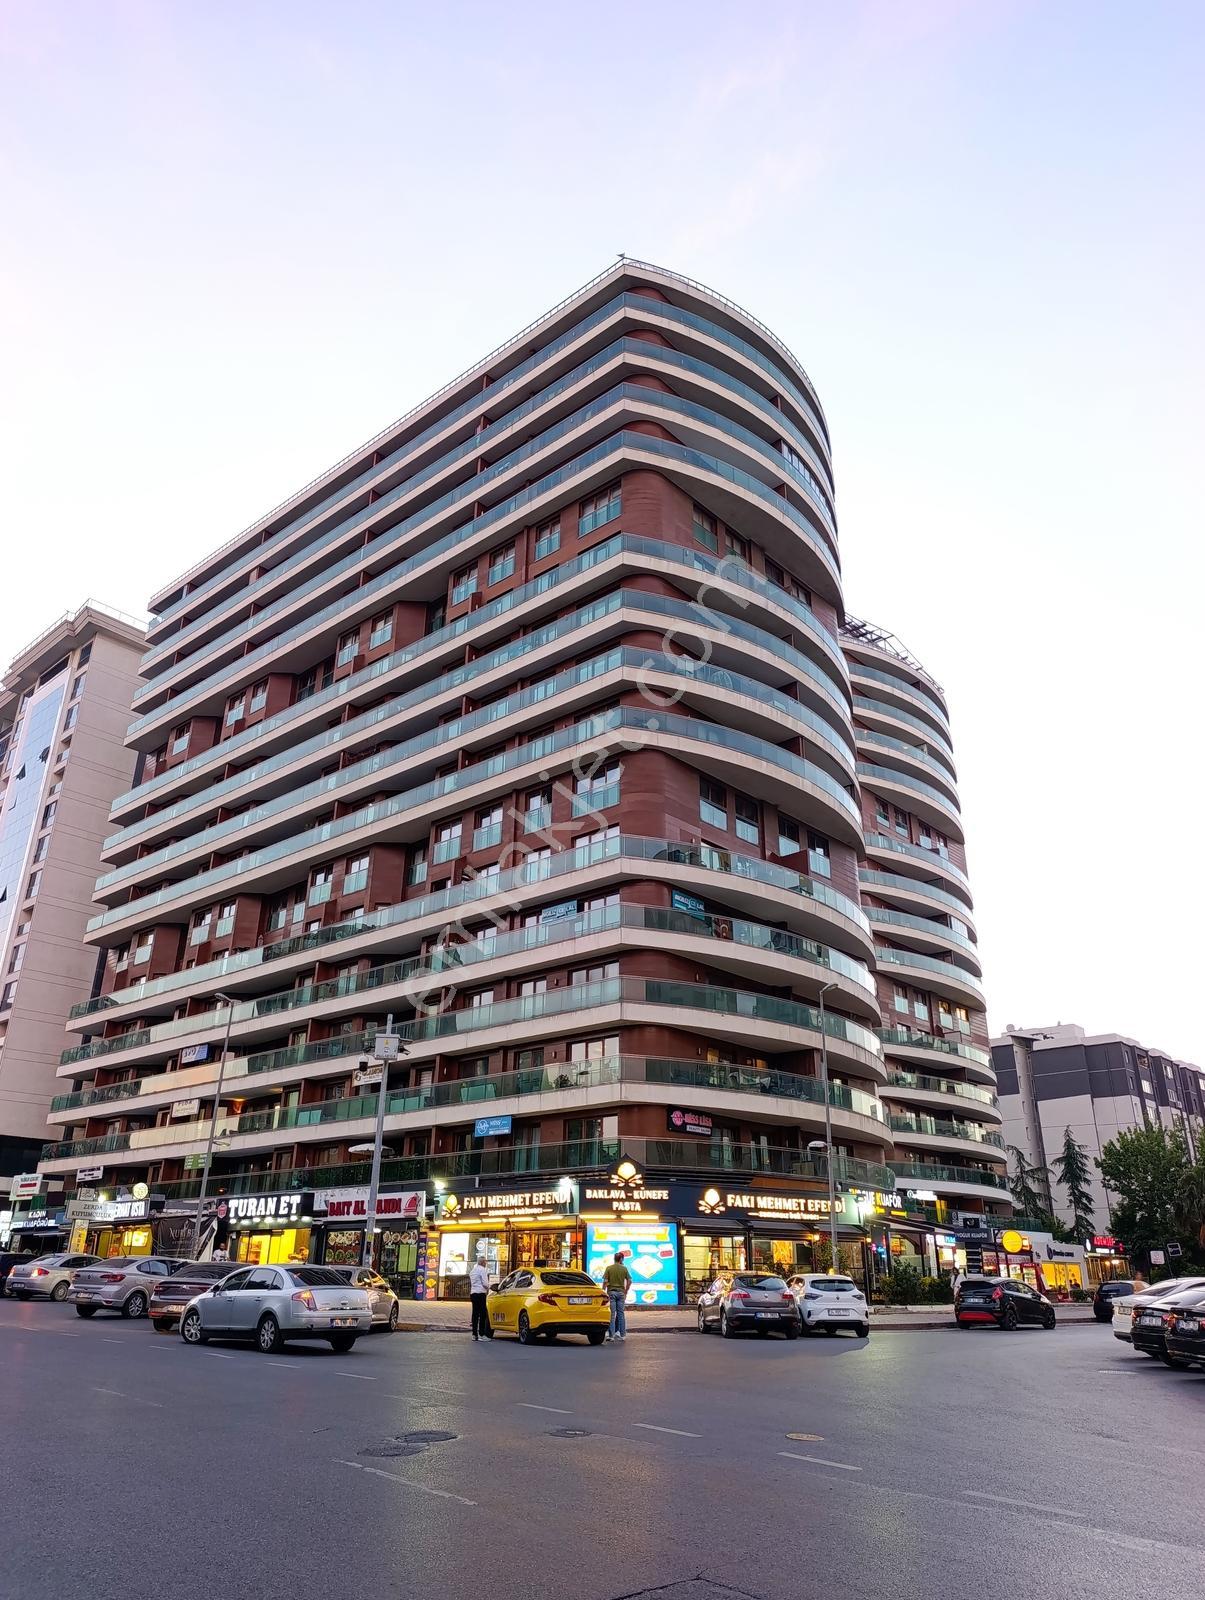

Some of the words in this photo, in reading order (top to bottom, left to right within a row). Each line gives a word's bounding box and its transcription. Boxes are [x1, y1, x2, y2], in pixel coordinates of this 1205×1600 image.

[463, 1196, 486, 1209] FAKI
[487, 1193, 531, 1208] MEHMET
[585, 1189, 626, 1199] BAKLAVA
[633, 1187, 669, 1200] KÜNEFE
[875, 1191, 902, 1208] KUAFÖR
[229, 1197, 276, 1217] TURAN
[278, 1196, 301, 1214] ET
[353, 1200, 366, 1215] AL
[368, 1198, 402, 1214] ANDI
[612, 1201, 642, 1211] PASTA
[726, 1194, 755, 1208] FAKI
[756, 1195, 805, 1211] MEHMET
[23, 1217, 48, 1227] KUAFÖRÜ
[28, 1210, 47, 1218] KADIN
